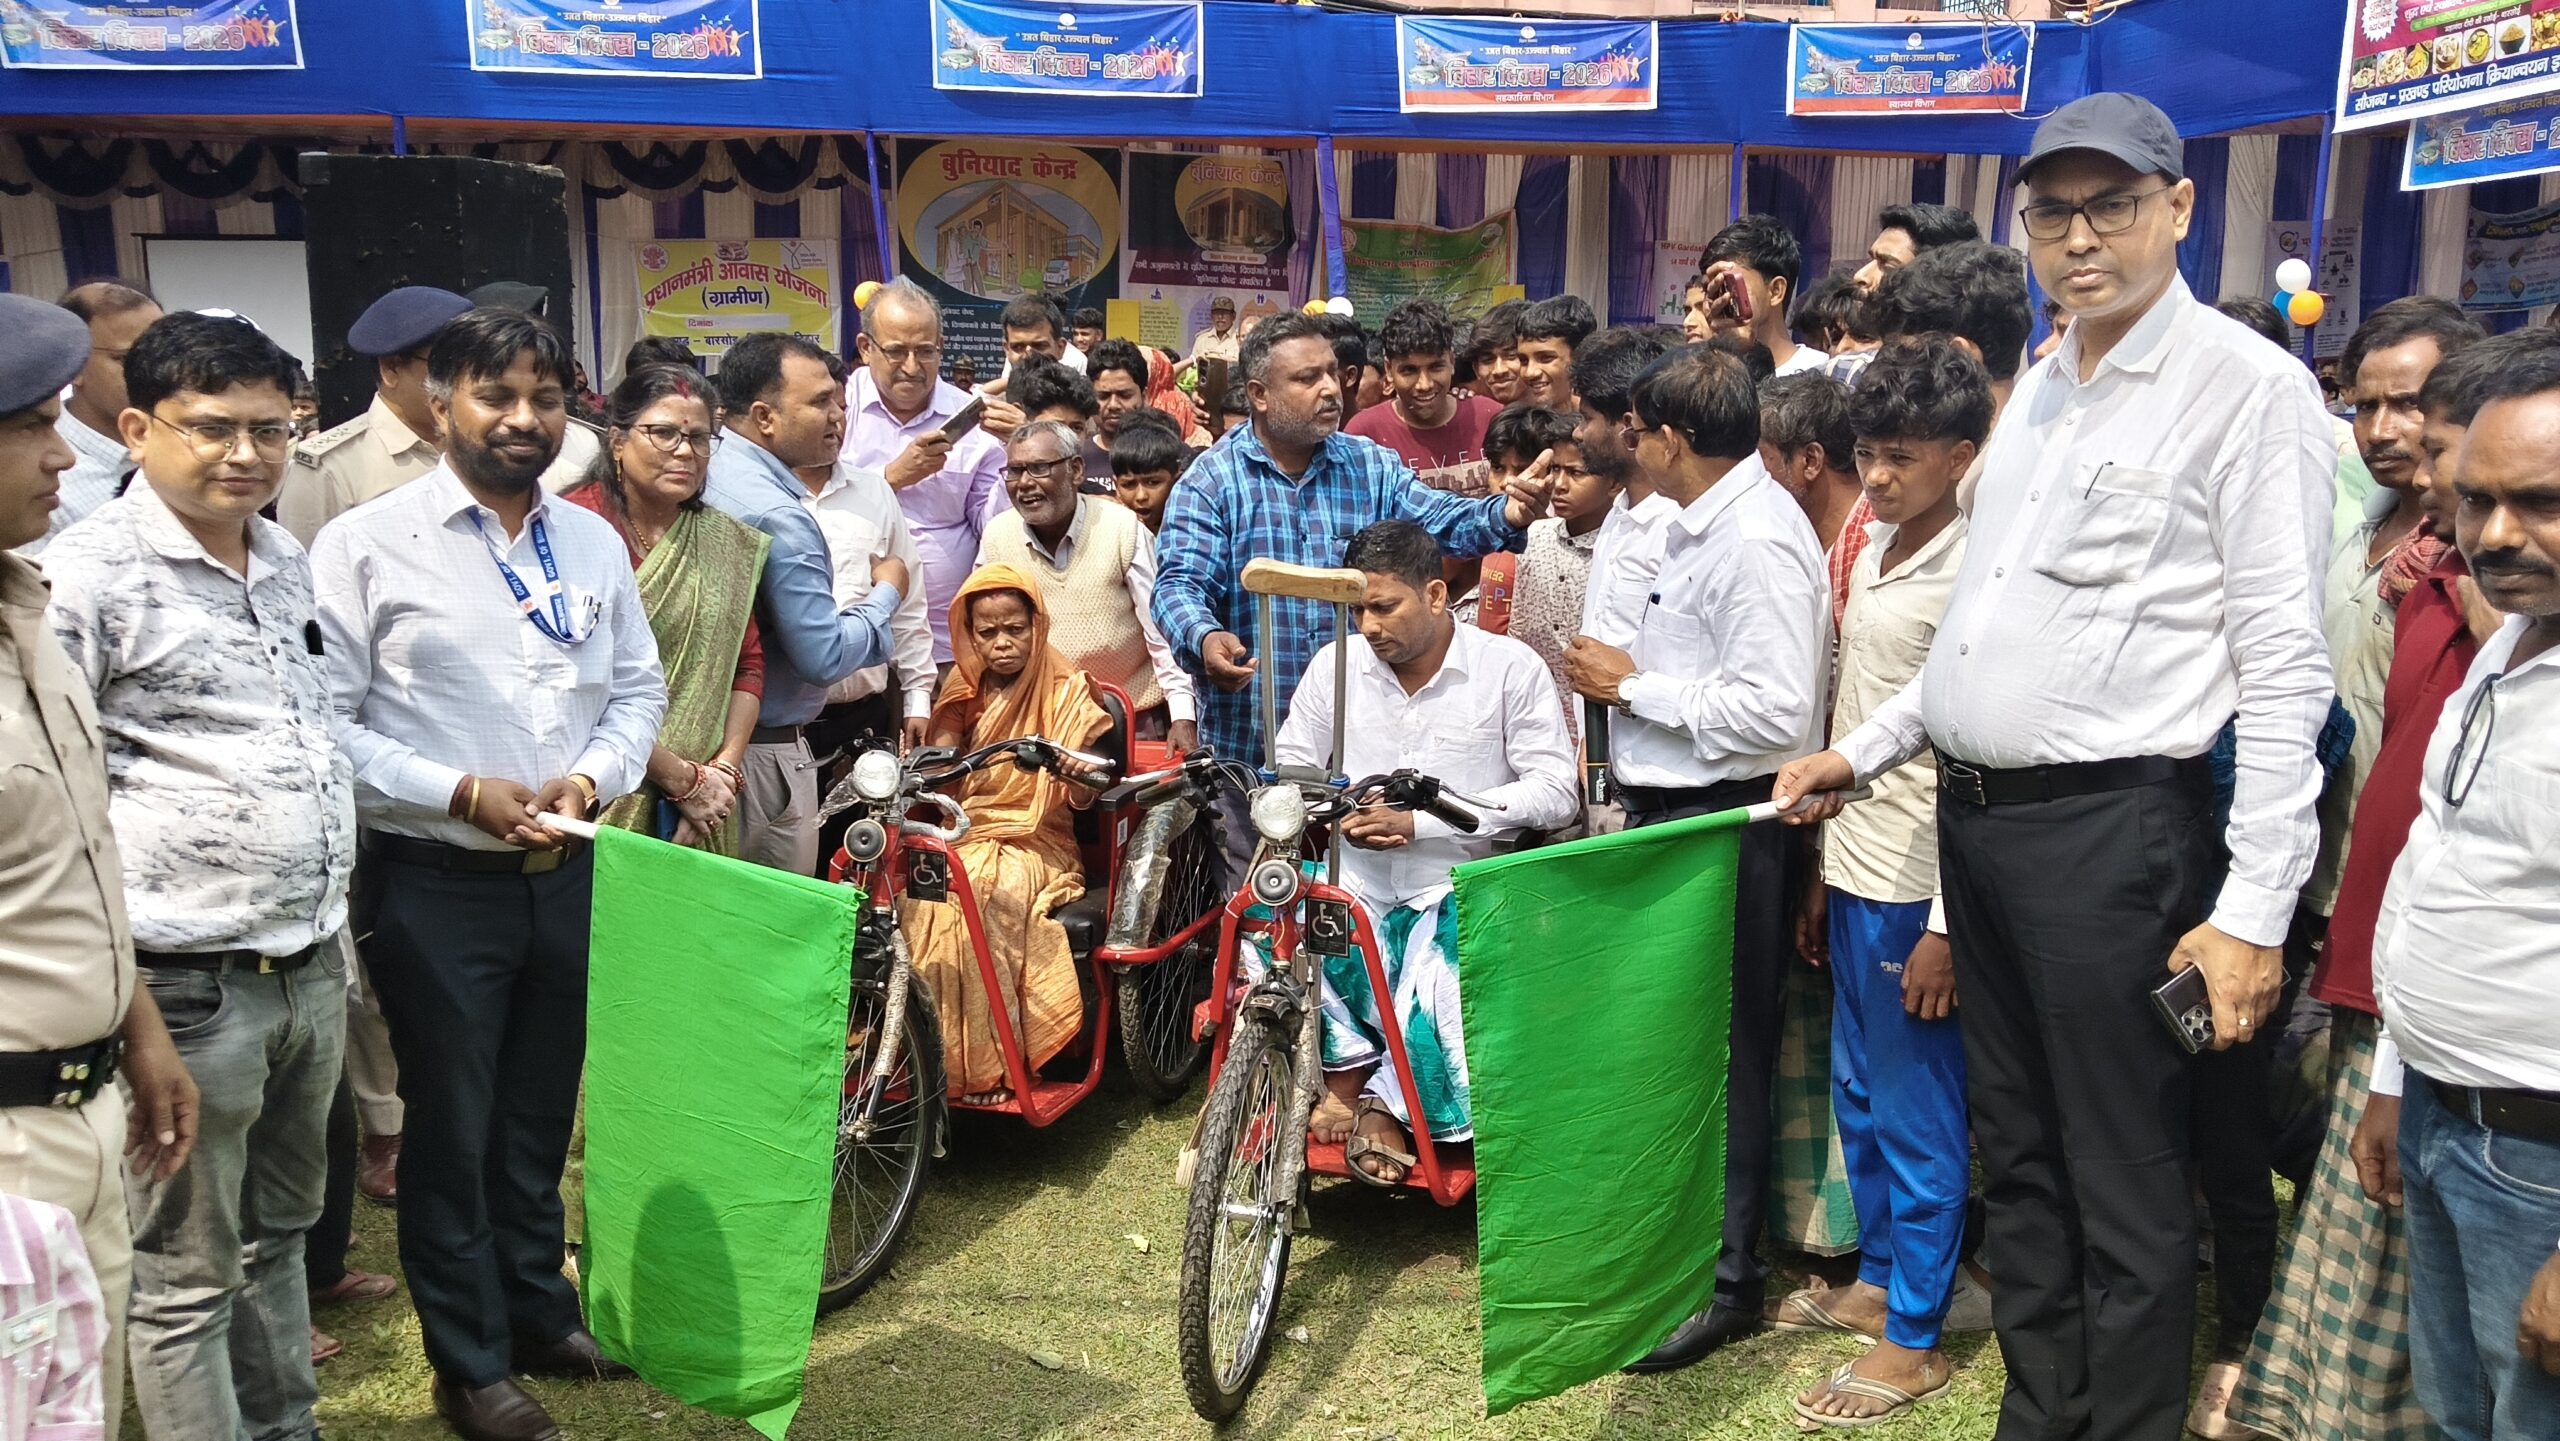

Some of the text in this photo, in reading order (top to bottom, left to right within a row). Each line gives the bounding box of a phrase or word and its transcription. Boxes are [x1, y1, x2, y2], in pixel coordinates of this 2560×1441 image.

[39, 19, 103, 50] बिहार
[103, 19, 166, 51] दिवस
[183, 25, 246, 51] 2026
[518, 23, 578, 54] बिहार
[578, 24, 636, 57] दिवस
[652, 33, 709, 59] 2026
[978, 45, 1036, 75] बिहार
[1036, 46, 1088, 77] दिवस
[1104, 54, 1156, 79] 2026
[1444, 59, 1499, 87] बिहार
[1499, 58, 1548, 87] दिवस
[1562, 63, 1613, 87] 2026
[1834, 67, 1884, 94] बिहार
[1884, 65, 1932, 94] दिवस
[1944, 70, 1992, 93] 2026
[2354, 92, 2388, 112] सौजन्य
[2398, 83, 2430, 105] प्रखण्ड
[2432, 72, 2484, 96] परियोजना
[2486, 58, 2548, 86] क्रियान्वयन
[2443, 127, 2487, 165] बिहार
[2487, 119, 2538, 158] दिवस
[939, 148, 1078, 181] बुनियाद केन्द्र
[1191, 159, 1281, 187] बुनियाद केन्द्र
[643, 257, 828, 314] प्रधानमंत्री आवास योजना
[701, 285, 770, 310] (ग्रामीण)
[539, 546, 549, 556] OF
